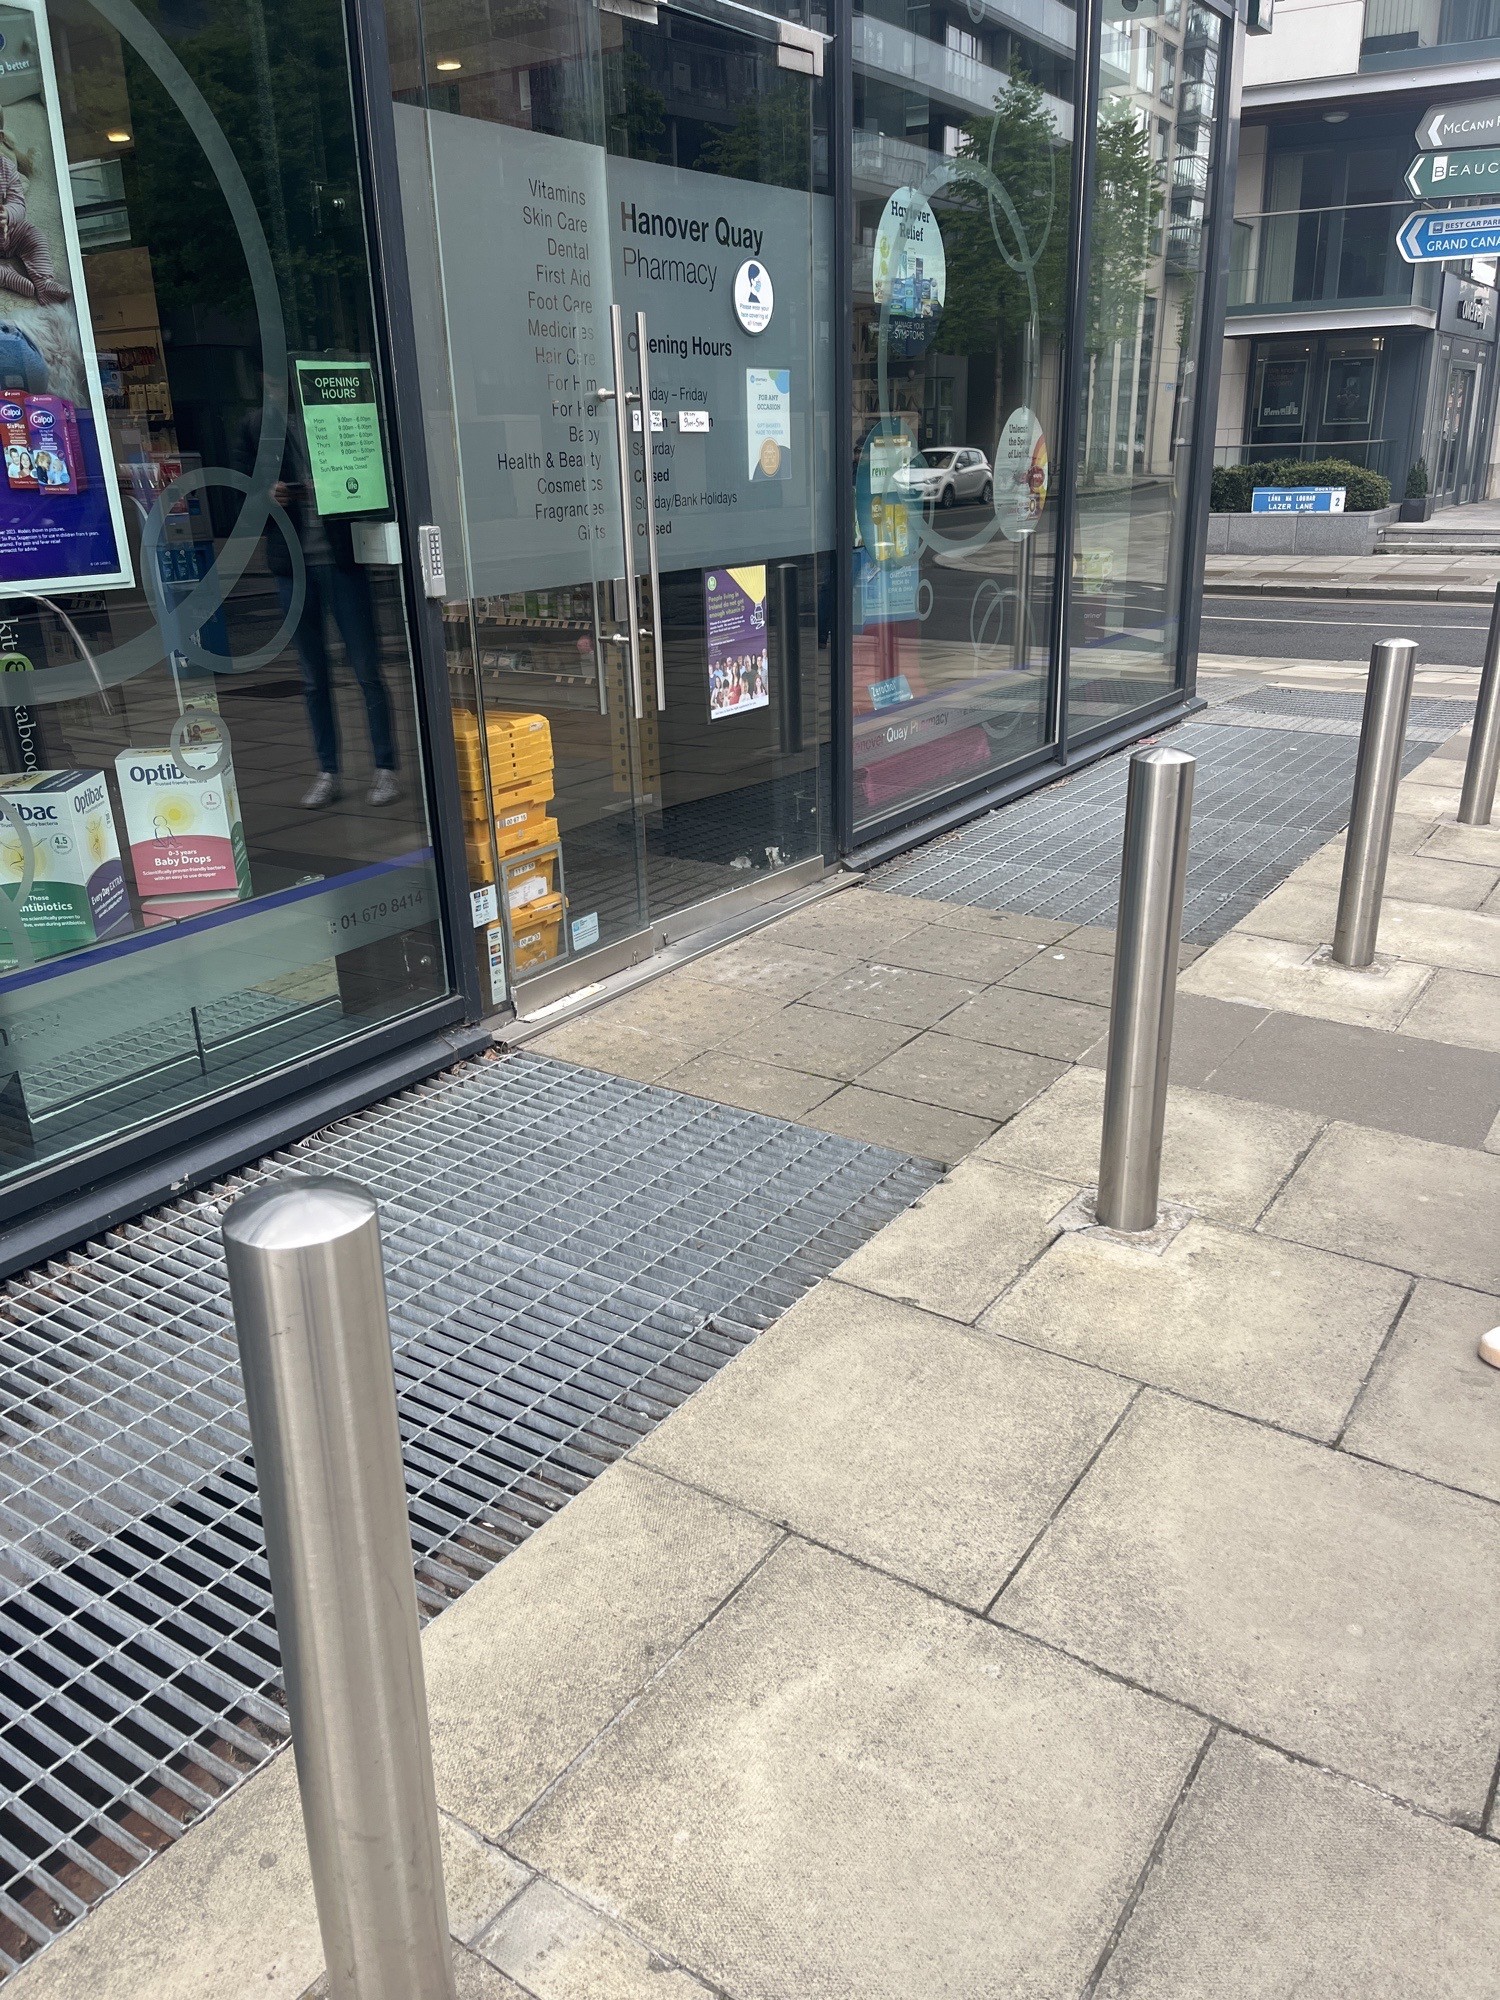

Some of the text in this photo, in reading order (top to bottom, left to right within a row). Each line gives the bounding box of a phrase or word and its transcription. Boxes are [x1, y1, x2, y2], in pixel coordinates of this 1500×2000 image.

[6, 60, 30, 71] better
[1444, 119, 1494, 134] McCann
[528, 178, 586, 206] Vitamins
[523, 206, 588, 233] Skin Care
[1446, 220, 1464, 228] BEST
[1466, 220, 1482, 228] CAR
[621, 202, 763, 256] Hanover Quay
[900, 222, 924, 242] Relief
[548, 238, 589, 260] Dental
[1426, 238, 1468, 252] GRAND
[536, 264, 590, 287] First Aid
[623, 246, 717, 292] Pharmacy
[528, 290, 592, 314] Foot Care
[894, 330, 924, 340] SYMPTOMS
[628, 332, 732, 359] Oening Hours
[535, 347, 561, 364] Hair
[315, 377, 360, 388] OPENING
[548, 374, 596, 391] For Hm
[322, 389, 356, 399] HOURS
[680, 387, 708, 404] Friday
[3, 408, 21, 417] Calpol
[552, 401, 572, 417] For
[33, 415, 53, 424] Calpol
[632, 442, 675, 458] Saurday
[498, 453, 541, 470] Health
[546, 452, 554, 468] &
[634, 468, 670, 483] Clsed
[872, 467, 887, 476] reviv
[636, 492, 738, 511] Suday/Bank Holidays
[1335, 498, 1340, 507] 2
[578, 525, 606, 540] Gits
[637, 521, 672, 536] Clsed
[886, 725, 908, 742] Quay
[74, 785, 104, 814] Optibac
[54, 837, 68, 845] 4.5
[155, 855, 212, 866] Baby Drops
[142, 868, 172, 876] Scientifically
[92, 892, 102, 906] Every
[101, 888, 110, 896] Day
[109, 876, 123, 890] EXTRA
[20, 902, 73, 912] ntibiotics
[341, 890, 423, 930] 01 679 8414
